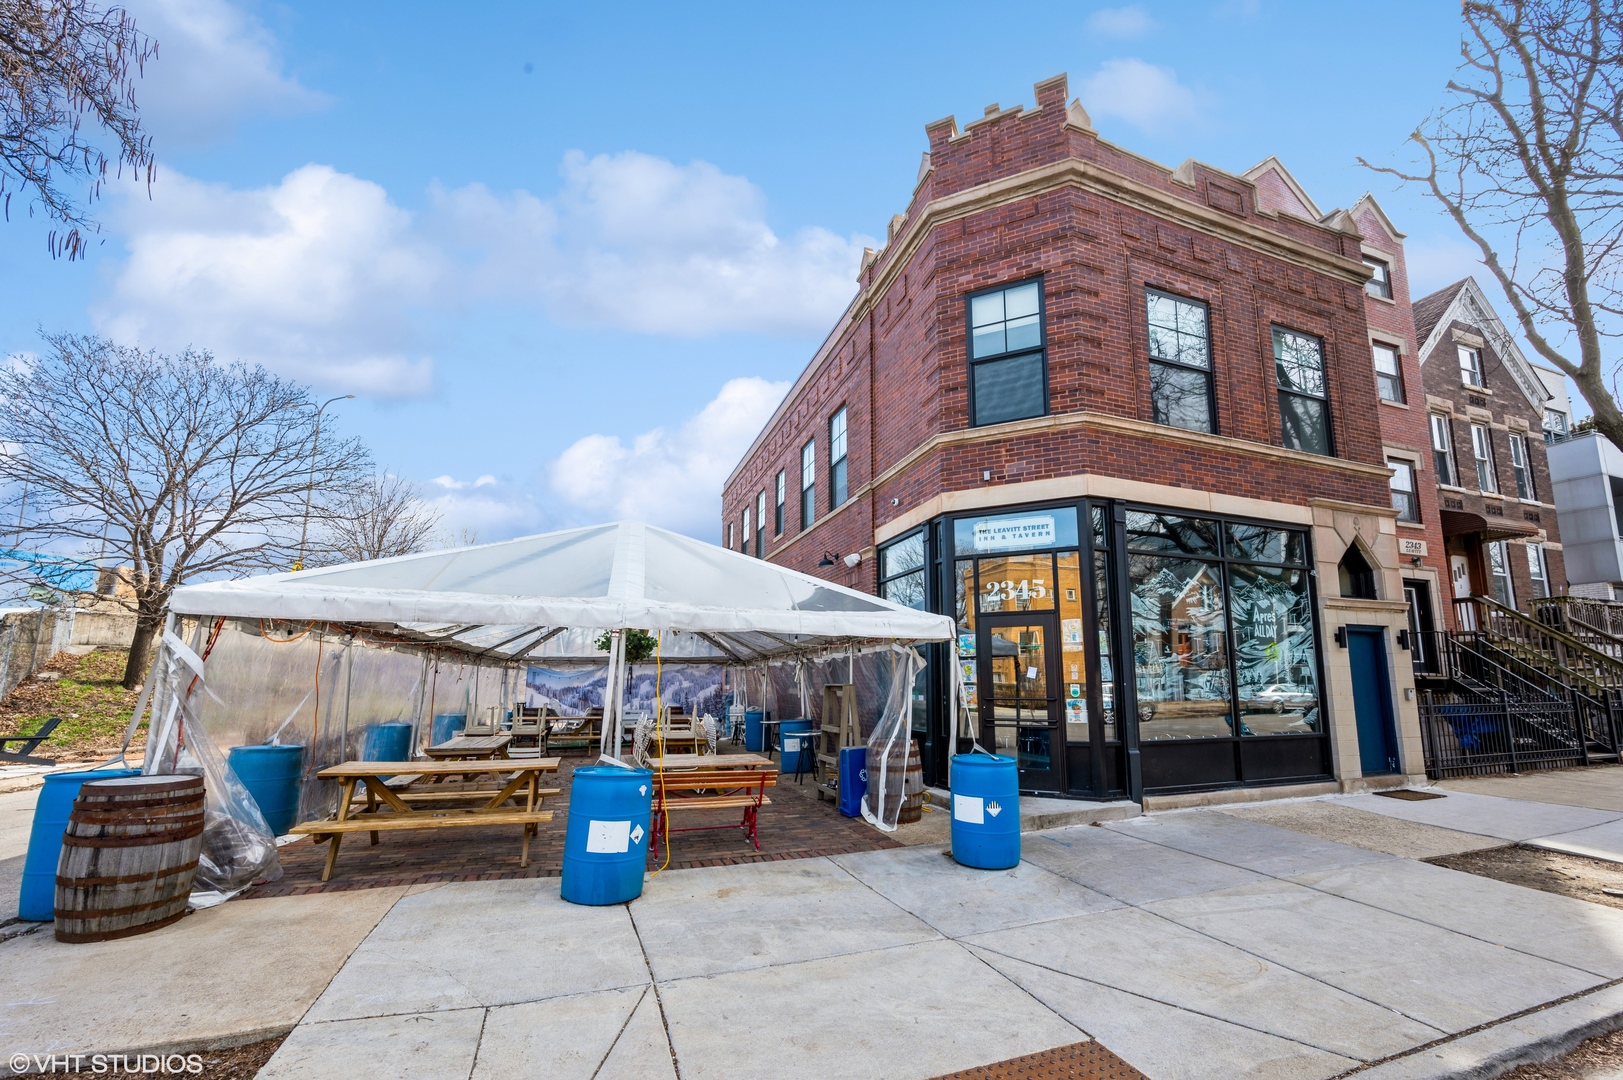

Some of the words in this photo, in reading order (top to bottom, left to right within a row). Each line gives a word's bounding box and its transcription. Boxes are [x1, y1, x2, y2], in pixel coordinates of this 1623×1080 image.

[993, 526, 1021, 534] LEAVITT
[1012, 531, 1051, 539] TAVERN
[986, 578, 1046, 601] 2345
[1266, 624, 1278, 638] DAY
